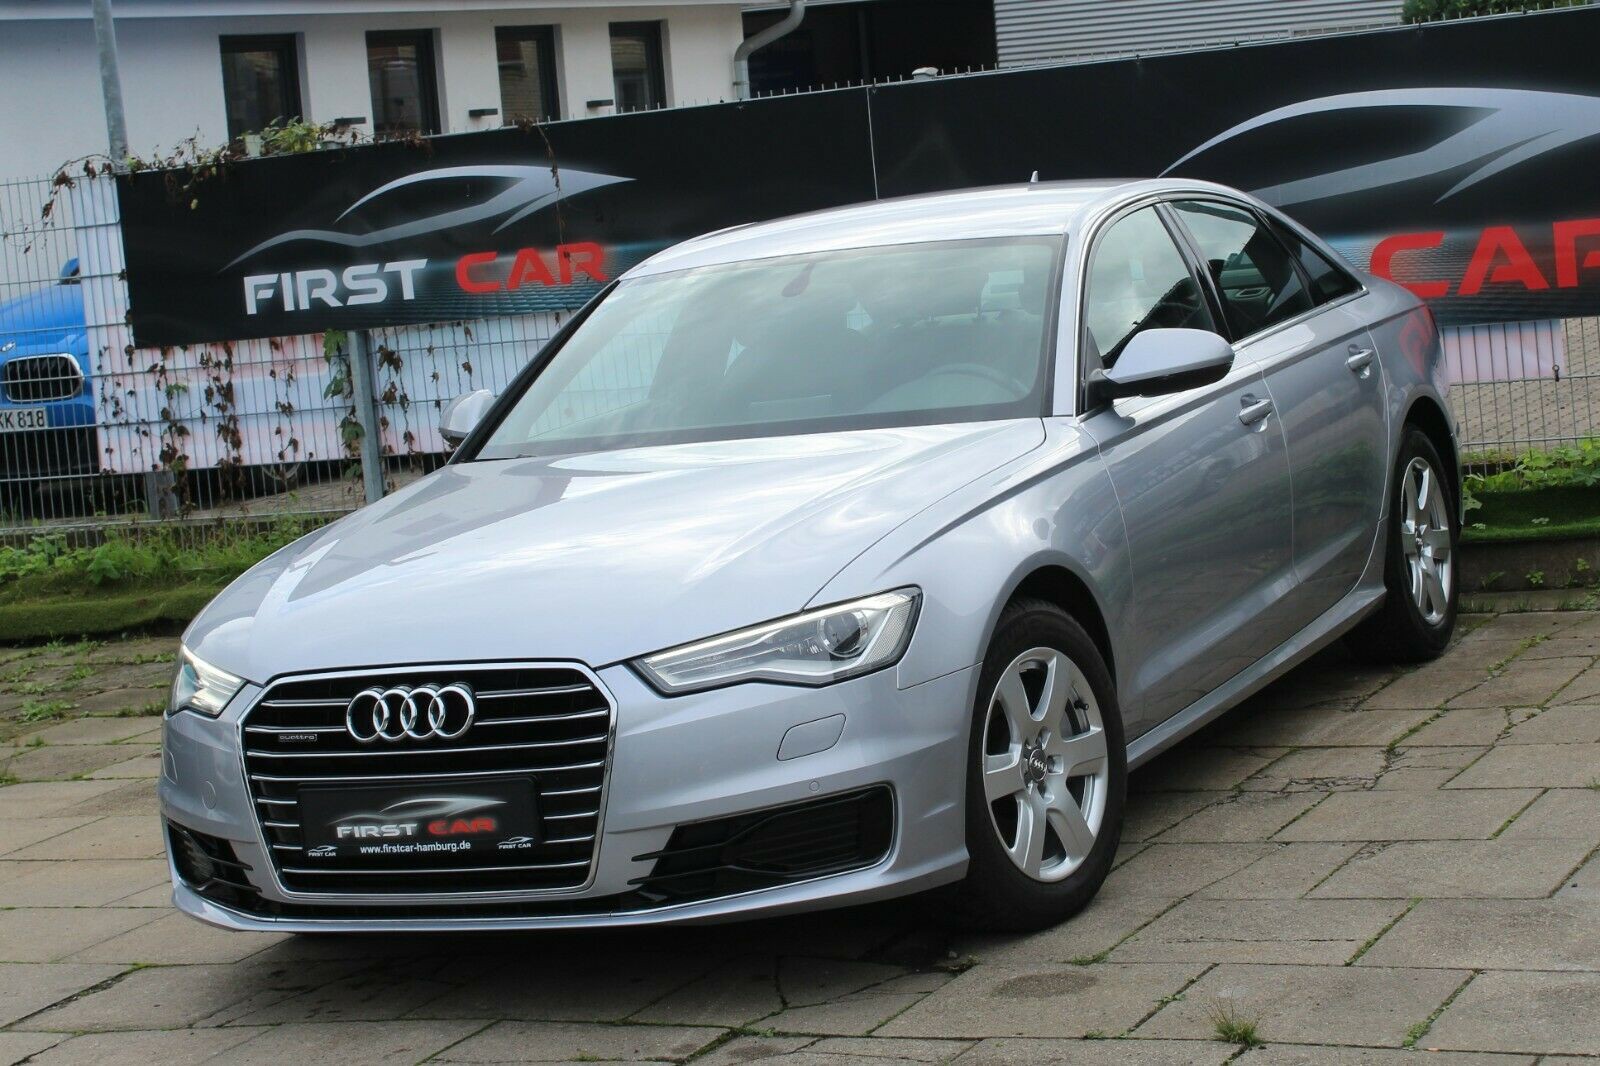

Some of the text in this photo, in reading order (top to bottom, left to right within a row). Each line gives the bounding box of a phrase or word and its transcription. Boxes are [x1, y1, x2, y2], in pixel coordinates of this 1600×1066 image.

[243, 242, 608, 315] FIRST CAR
[0, 410, 44, 429] K 818
[337, 818, 495, 838] FIRST CAR
[360, 840, 471, 854] www.firstcar-hamburg.de
